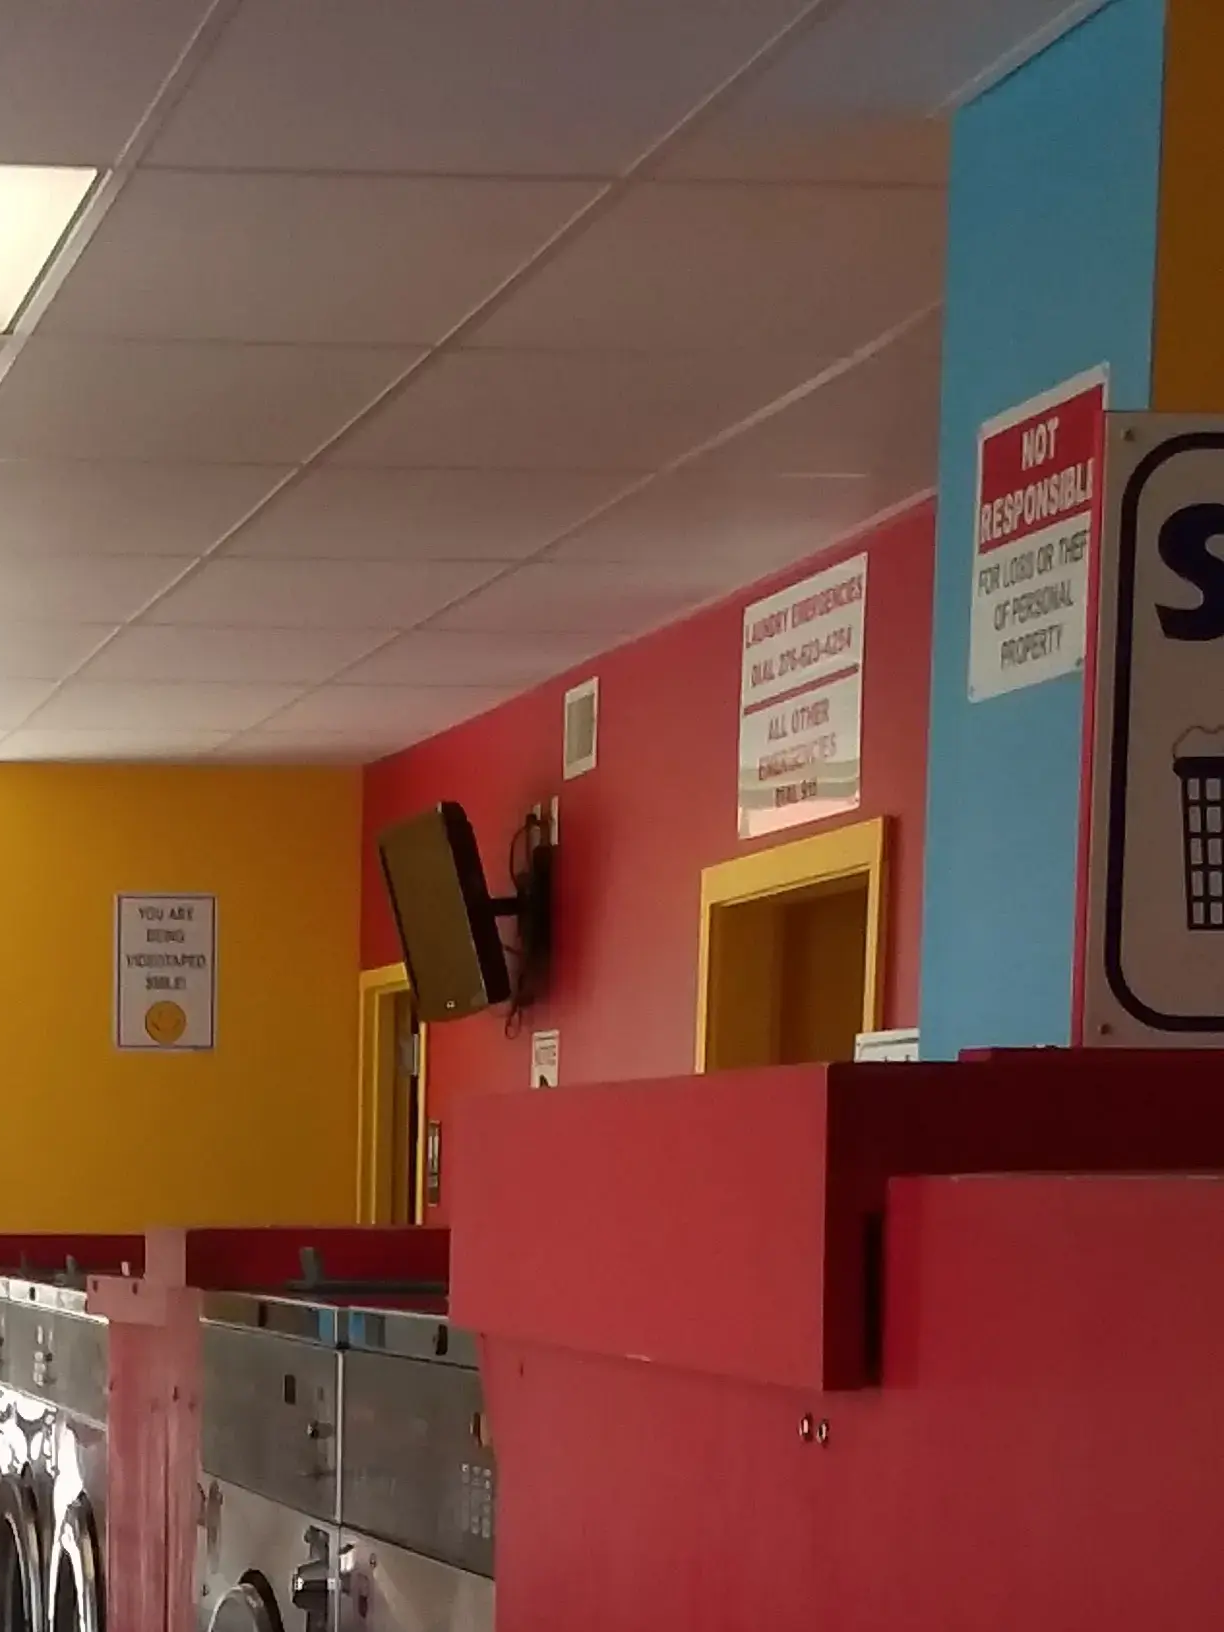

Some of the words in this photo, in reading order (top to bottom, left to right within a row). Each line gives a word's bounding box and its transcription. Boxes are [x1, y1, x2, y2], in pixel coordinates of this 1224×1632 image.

[1021, 416, 1059, 471] NOT
[977, 563, 1000, 599] FOR
[1036, 541, 1054, 577] OR
[1058, 529, 1090, 568] THEF
[745, 607, 789, 649] LAUNDRY
[993, 600, 1011, 631] OF
[1012, 578, 1074, 625] PERSONAL
[1000, 623, 1064, 670] PROPERTY
[768, 713, 789, 743] ALL
[791, 698, 830, 733] OTHER
[138, 906, 163, 921] YOU
[170, 906, 194, 921] ARE
